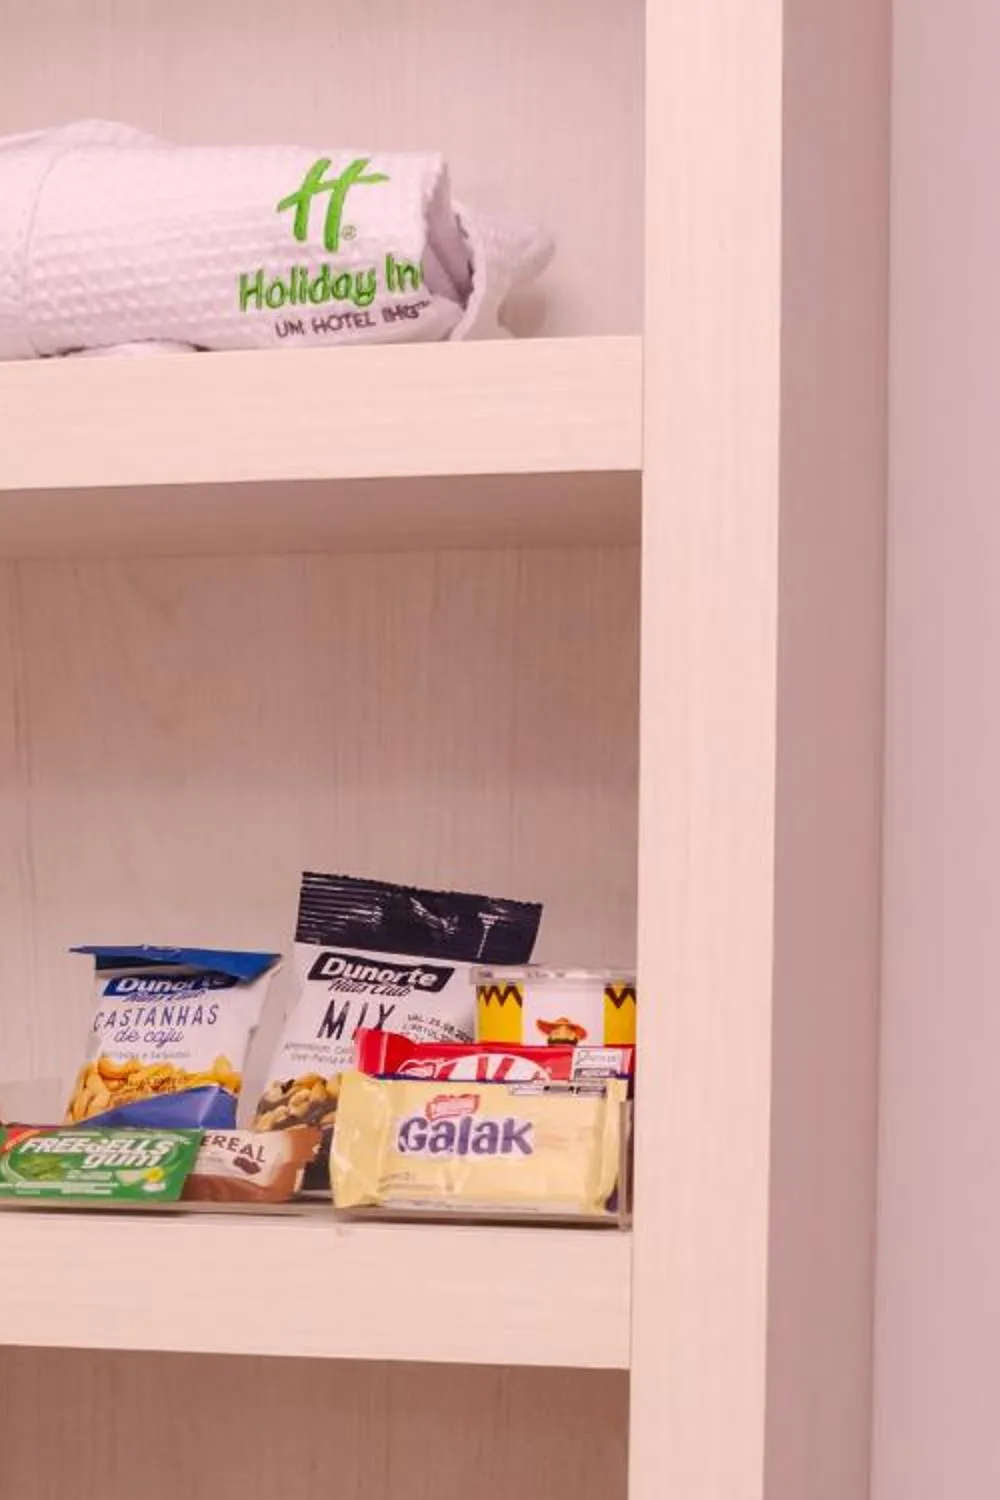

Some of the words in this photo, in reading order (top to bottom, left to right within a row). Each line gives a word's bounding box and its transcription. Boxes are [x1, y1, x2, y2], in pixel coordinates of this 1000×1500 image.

[239, 262, 377, 312] Holiday
[385, 253, 423, 293] In
[275, 320, 305, 339] UM
[312, 311, 376, 335] HOTEL
[320, 957, 439, 988] Dunorte
[93, 1003, 219, 1032] CASTANHAS
[113, 1026, 140, 1043] de
[199, 1133, 266, 1163] EREAL
[398, 1115, 533, 1156] Galak
